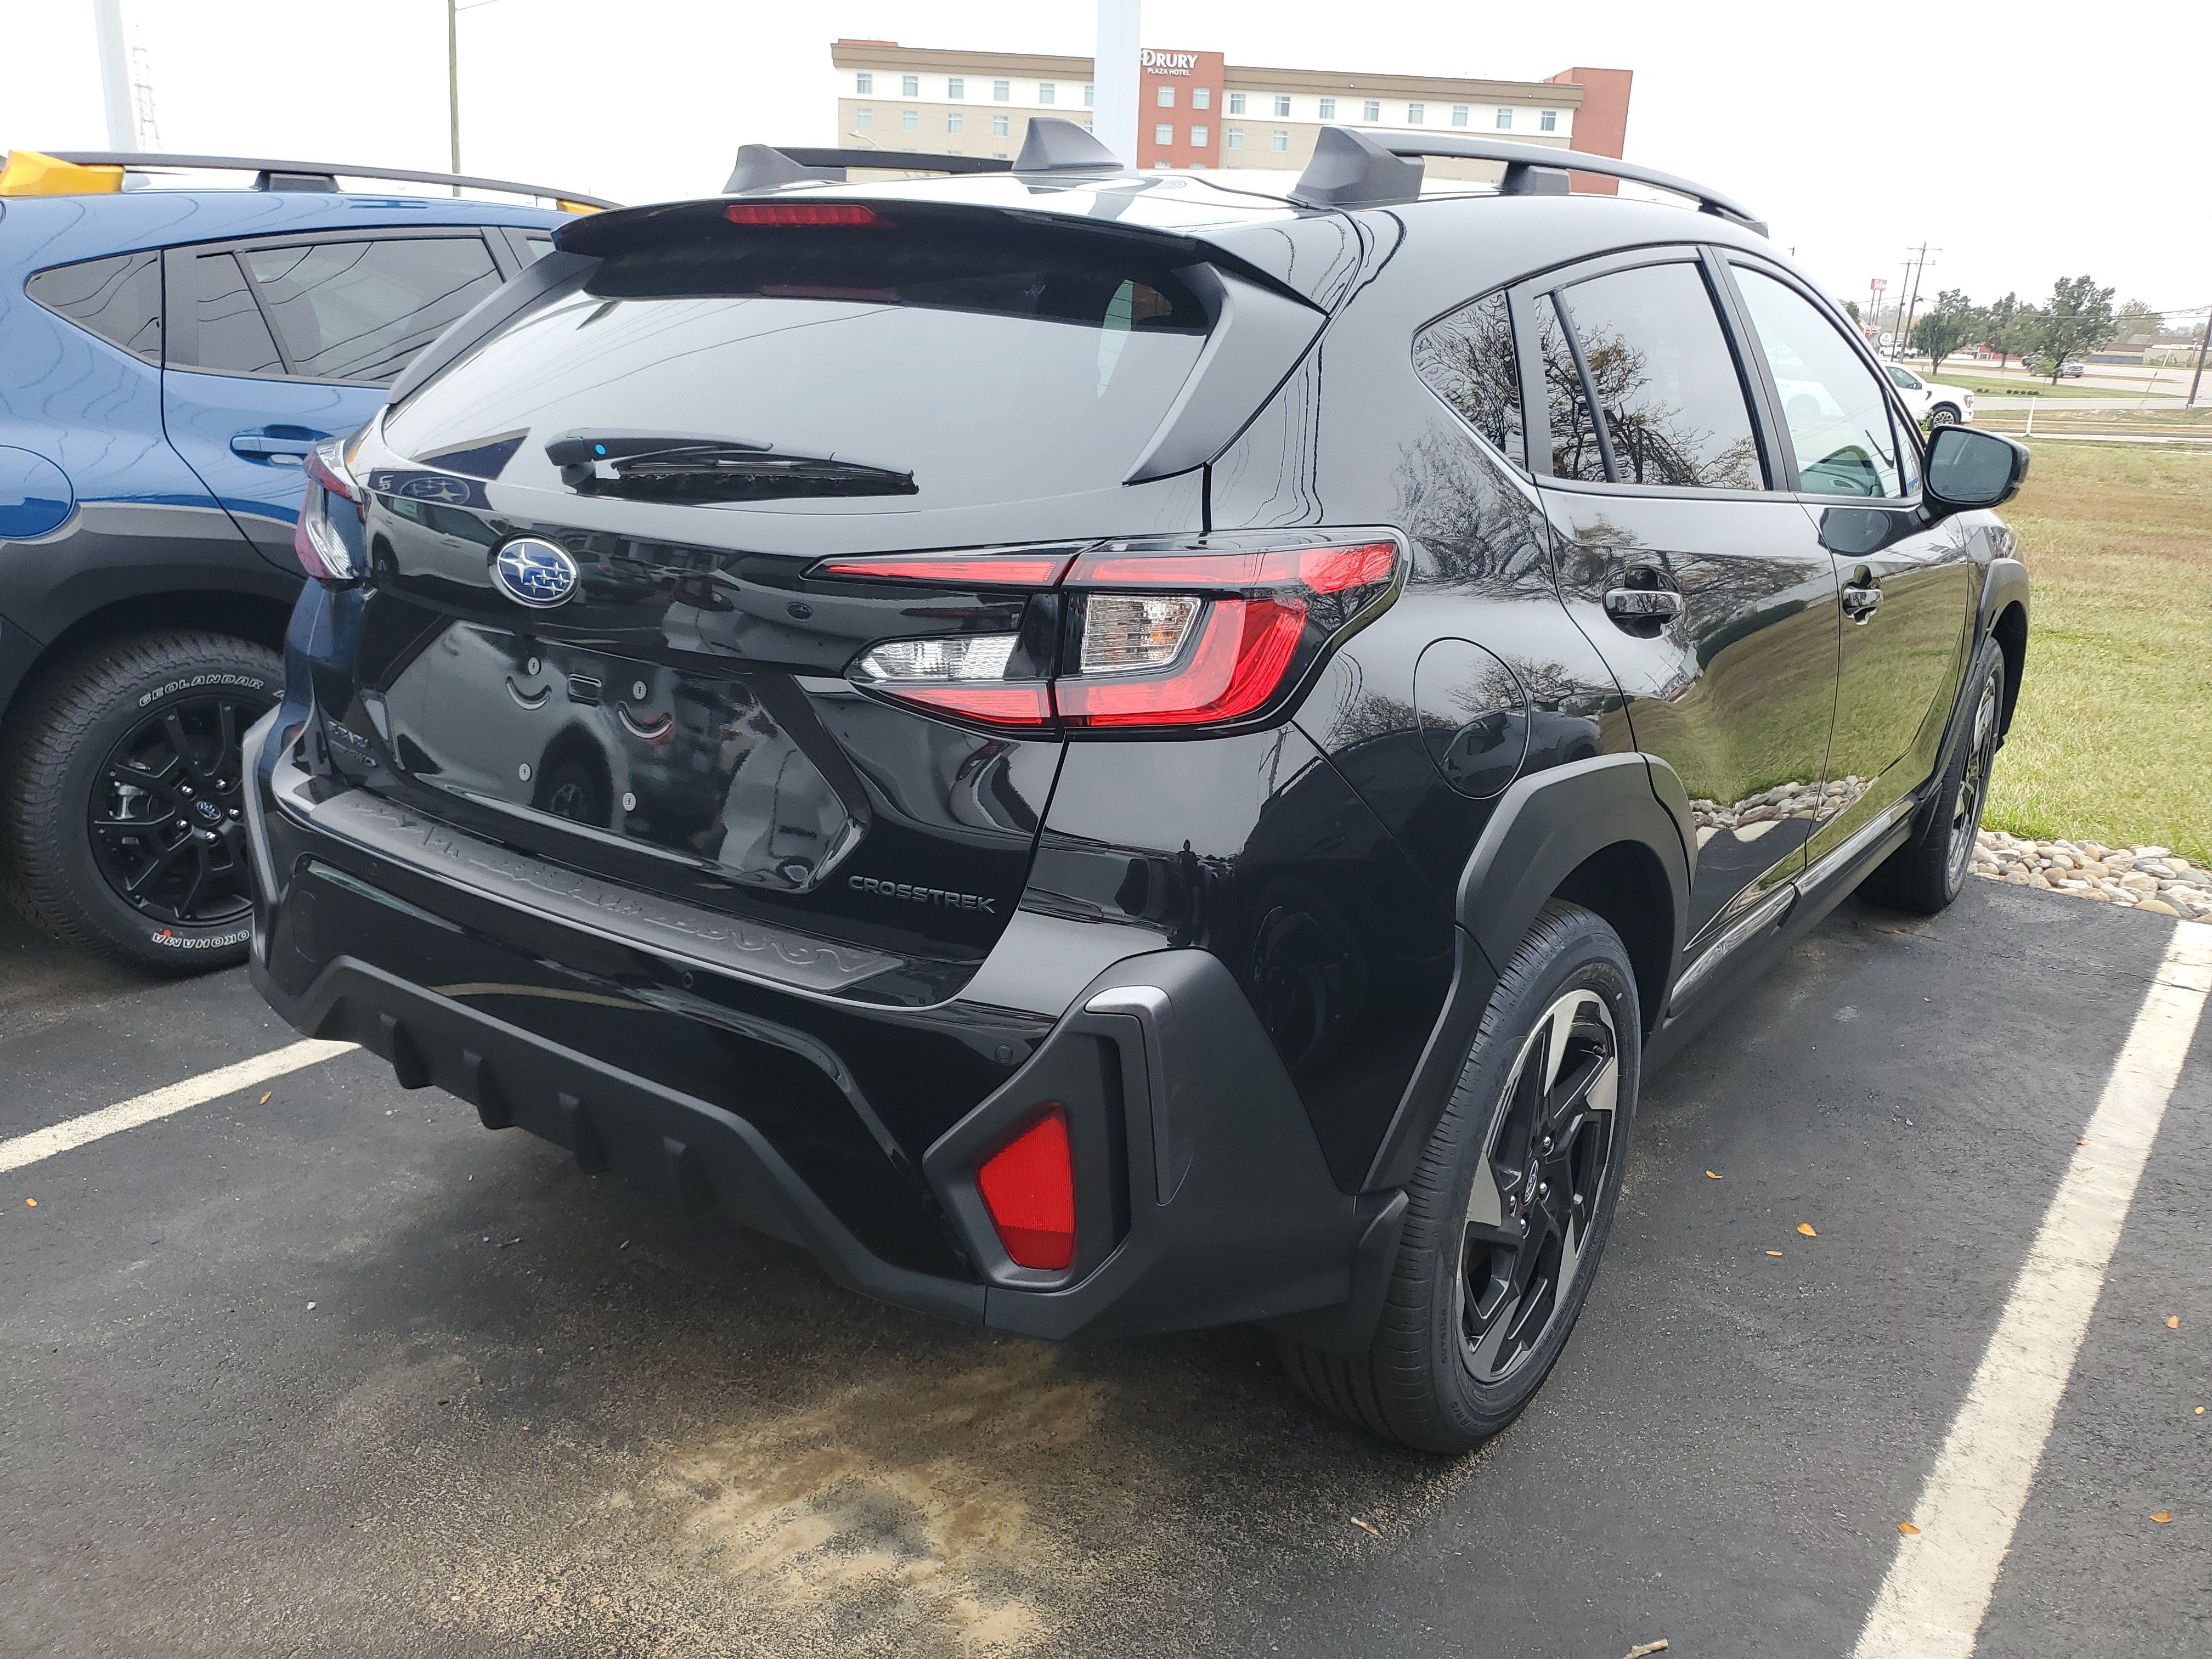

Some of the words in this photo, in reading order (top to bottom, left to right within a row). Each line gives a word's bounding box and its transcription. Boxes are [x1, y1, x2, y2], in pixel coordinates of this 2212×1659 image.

[1141, 49, 1198, 69] DRURY
[1169, 68, 1190, 76] HOTEL
[139, 674, 264, 707] GEOLANDAR
[848, 875, 996, 914] CROSSTREK
[152, 929, 250, 949] OKOHAMA
